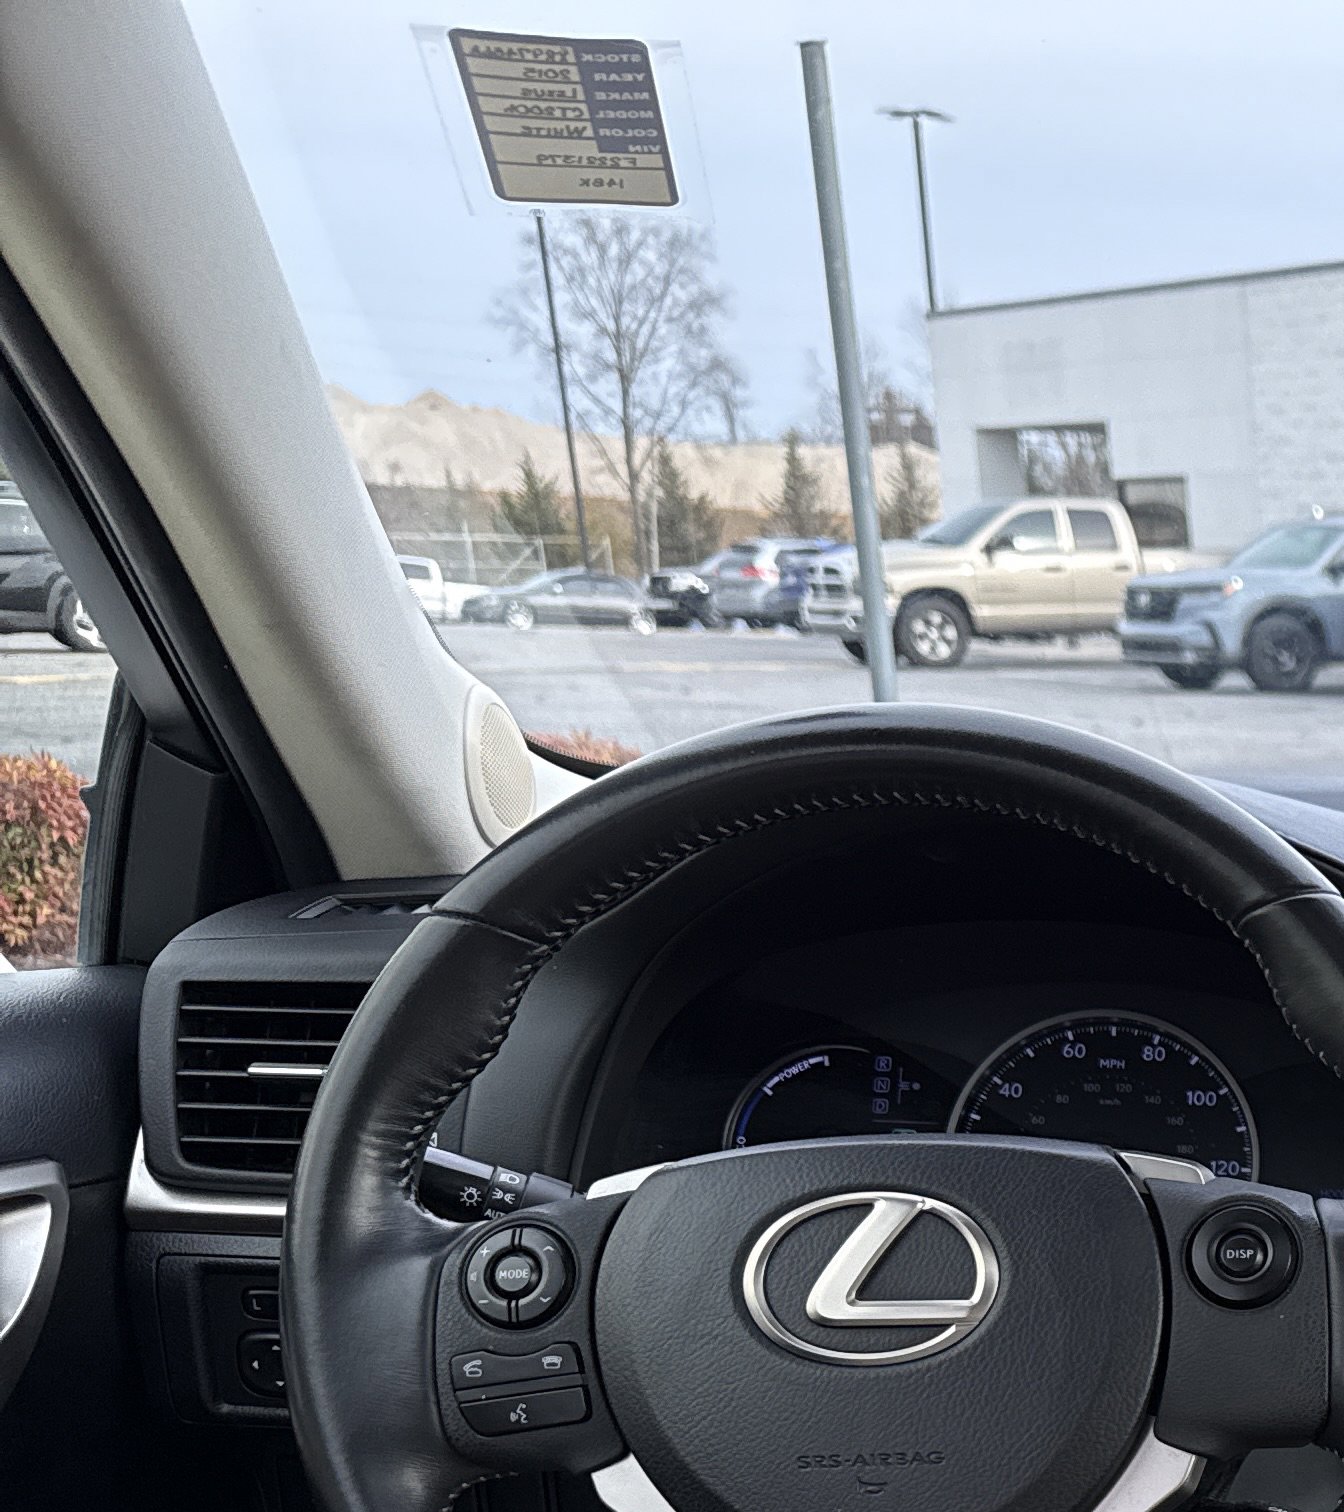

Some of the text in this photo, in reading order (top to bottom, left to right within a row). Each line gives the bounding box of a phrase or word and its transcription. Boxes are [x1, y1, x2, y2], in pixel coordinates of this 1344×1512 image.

[1062, 1042, 1087, 1060] 60
[1141, 1043, 1167, 1062] 80
[778, 1058, 812, 1082] POWER
[1099, 1058, 1127, 1070] MPH
[999, 1082, 1023, 1099] 40
[1083, 1082, 1102, 1093] 100
[1115, 1082, 1133, 1093] 120
[1185, 1089, 1218, 1107] 100
[1210, 1161, 1241, 1177] 120
[1226, 1249, 1255, 1260] DISP
[498, 1268, 530, 1281] MODE
